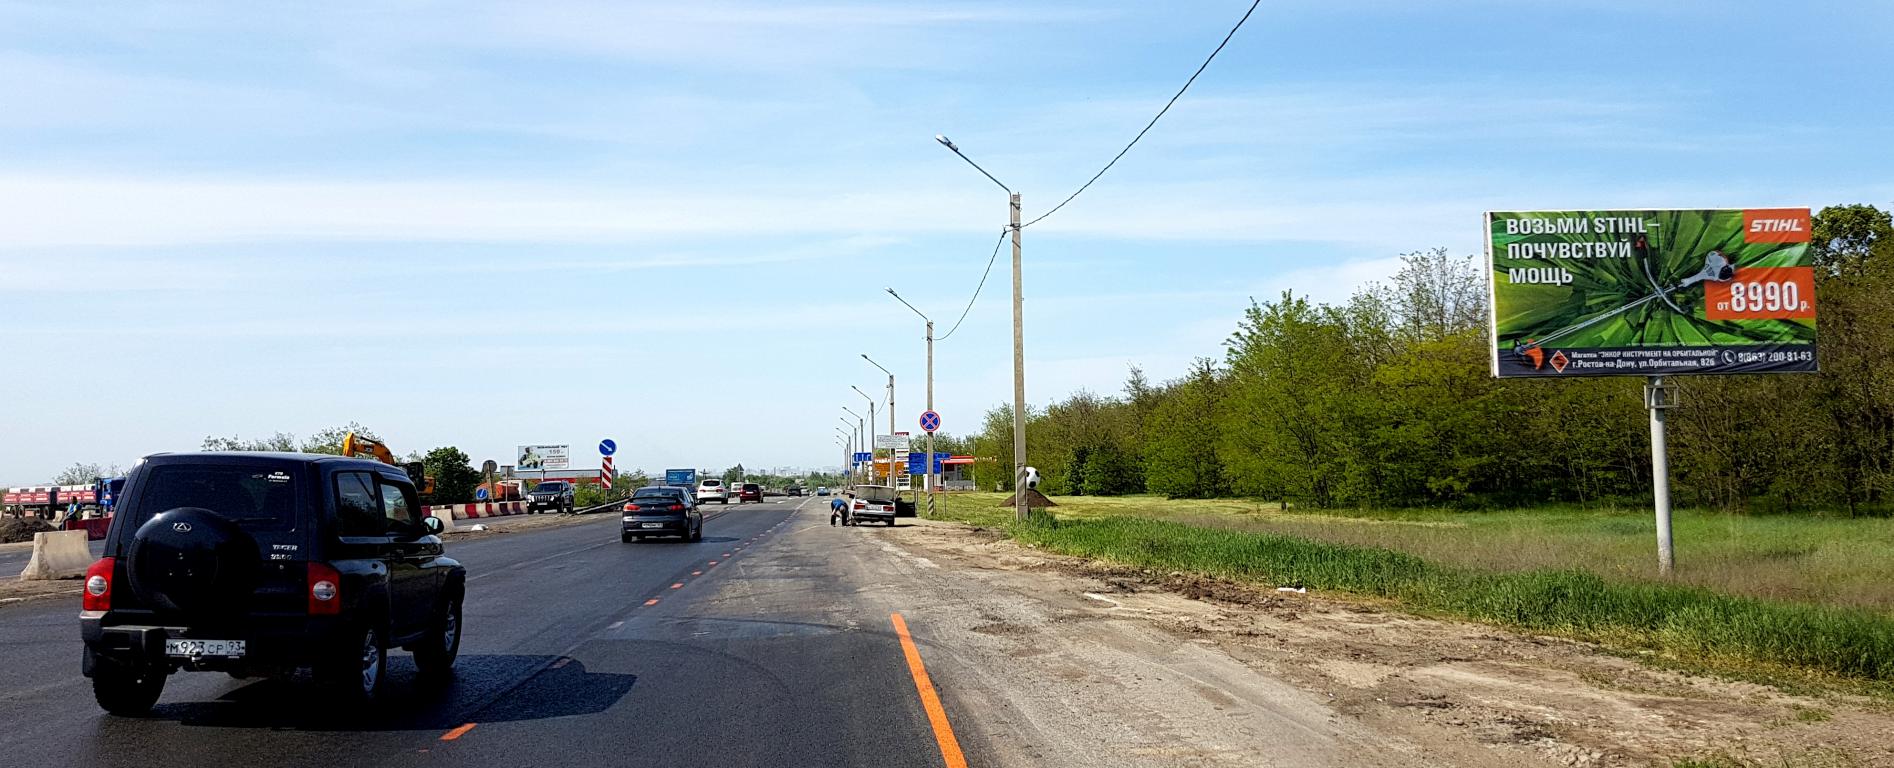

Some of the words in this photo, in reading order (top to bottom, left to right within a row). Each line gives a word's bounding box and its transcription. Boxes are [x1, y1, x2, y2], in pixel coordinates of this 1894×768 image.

[1506, 218, 1588, 235] ВОЗЬМИ
[1749, 219, 1802, 232] STIHL
[1507, 239, 1631, 259] ПОЧУВСТВУЙ
[1508, 267, 1573, 286] МОЩЬ
[1730, 281, 1798, 311] 8990
[1622, 350, 1662, 358] ИНСТРУМЕНТ
[1768, 352, 1812, 362] 200-81-63
